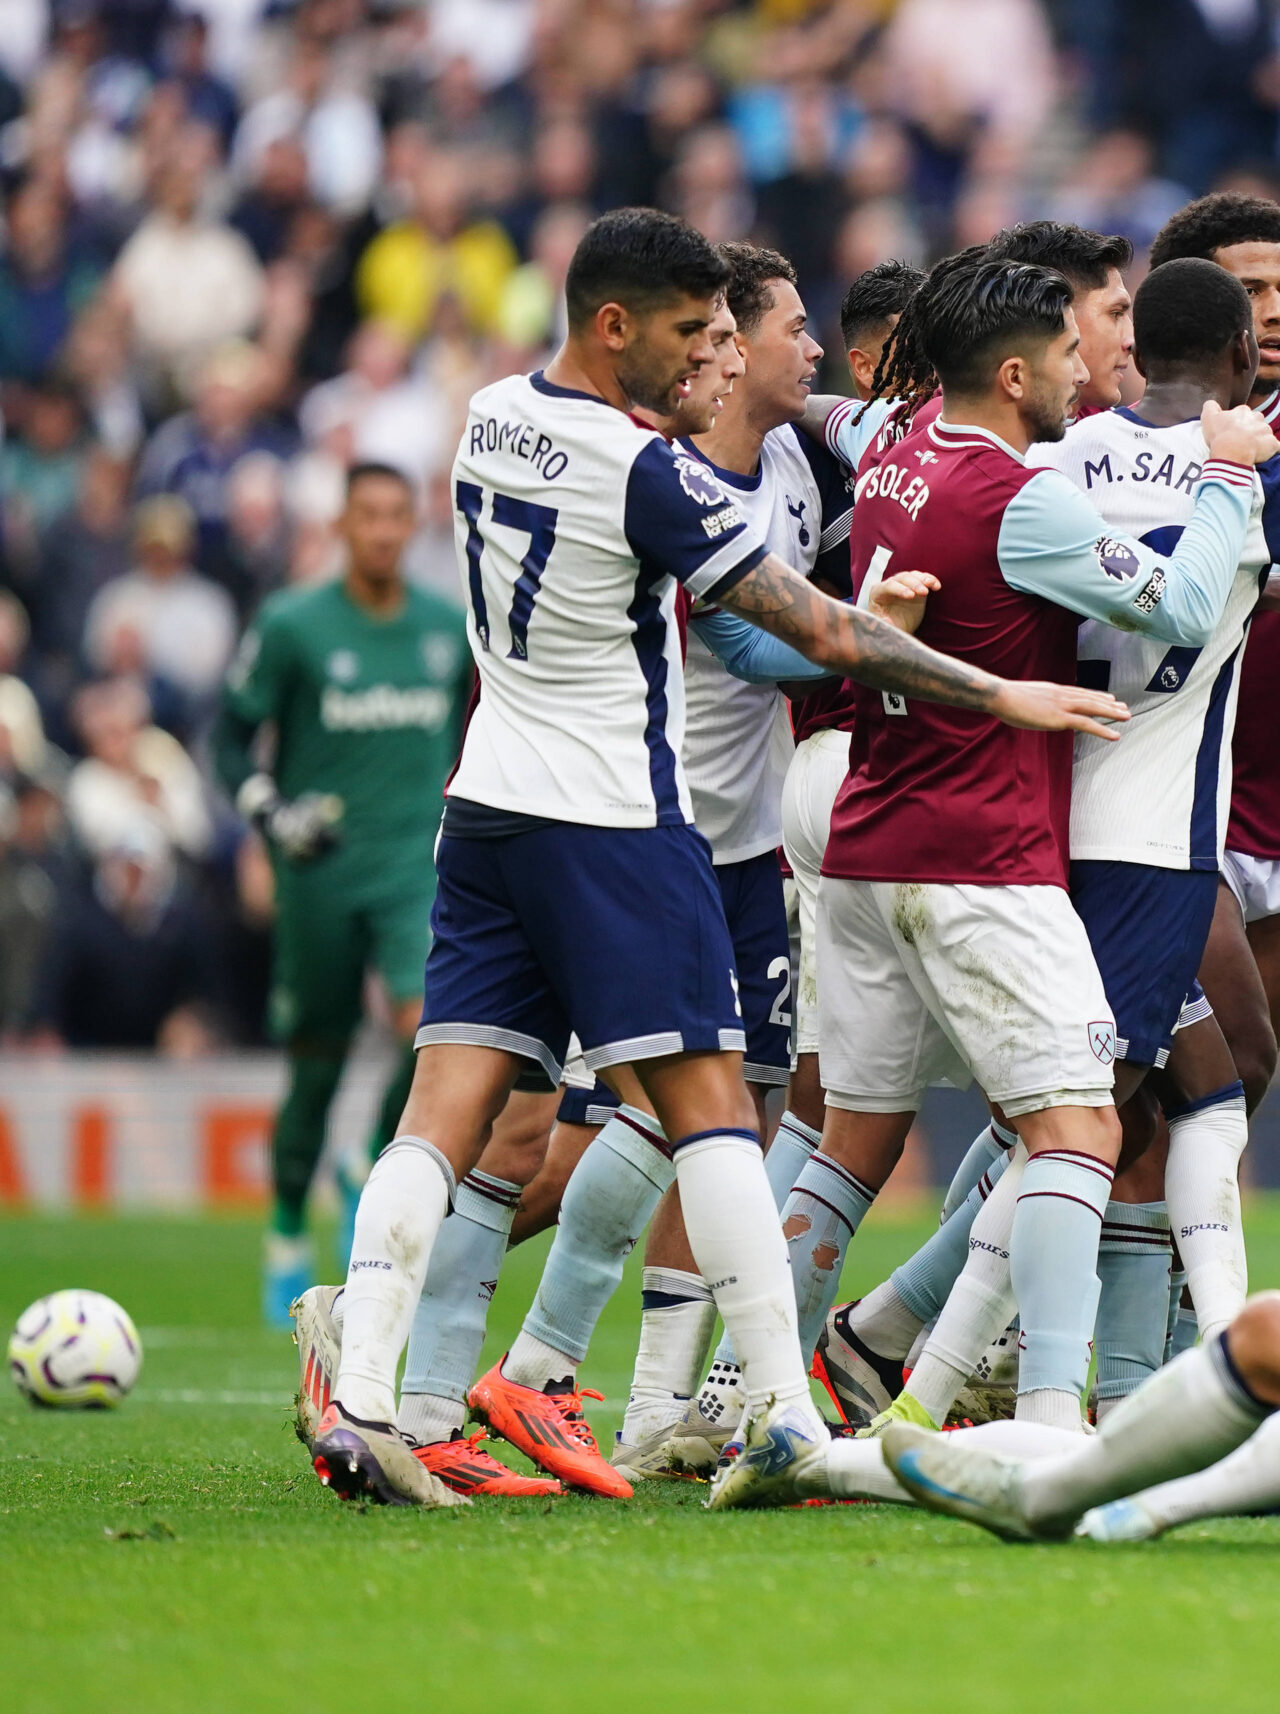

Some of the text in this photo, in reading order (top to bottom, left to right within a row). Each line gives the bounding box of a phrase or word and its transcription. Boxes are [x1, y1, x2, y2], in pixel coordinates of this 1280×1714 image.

[470, 417, 569, 481] ROMERO
[1084, 452, 1203, 496] M. SAR
[865, 463, 930, 522] SOLER
[701, 514, 720, 532] No
[456, 480, 559, 662] 17
[1133, 593, 1150, 610] No
[1181, 1223, 1229, 1239] Spurs
[969, 1237, 1010, 1259] Spurs
[350, 1260, 393, 1272] Spurs
